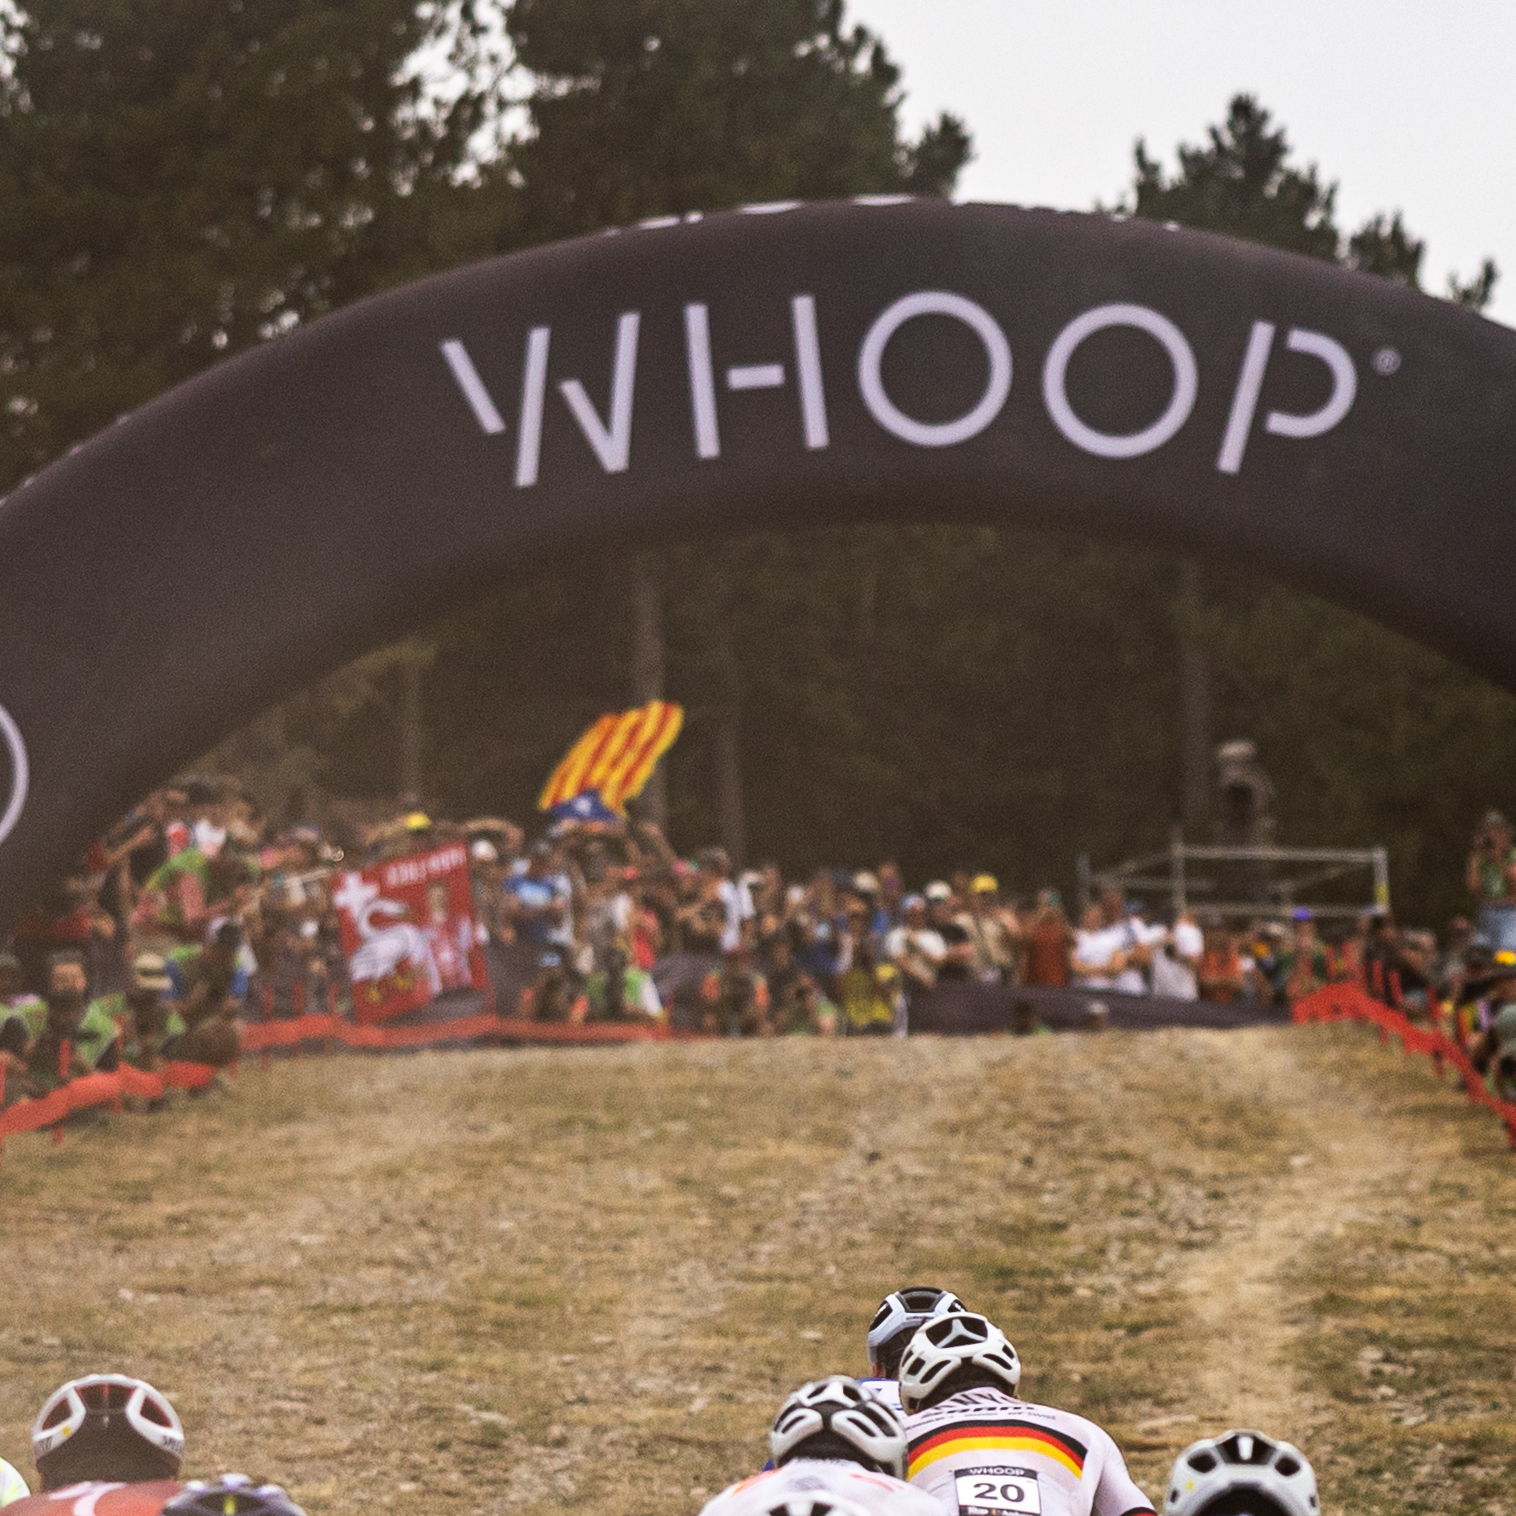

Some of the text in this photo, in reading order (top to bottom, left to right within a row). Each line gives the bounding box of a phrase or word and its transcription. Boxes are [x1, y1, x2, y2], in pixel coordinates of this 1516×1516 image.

[440, 289, 1358, 488] WHOOP
[969, 1467, 1025, 1476] WHOOP
[973, 1482, 1026, 1503] 20
